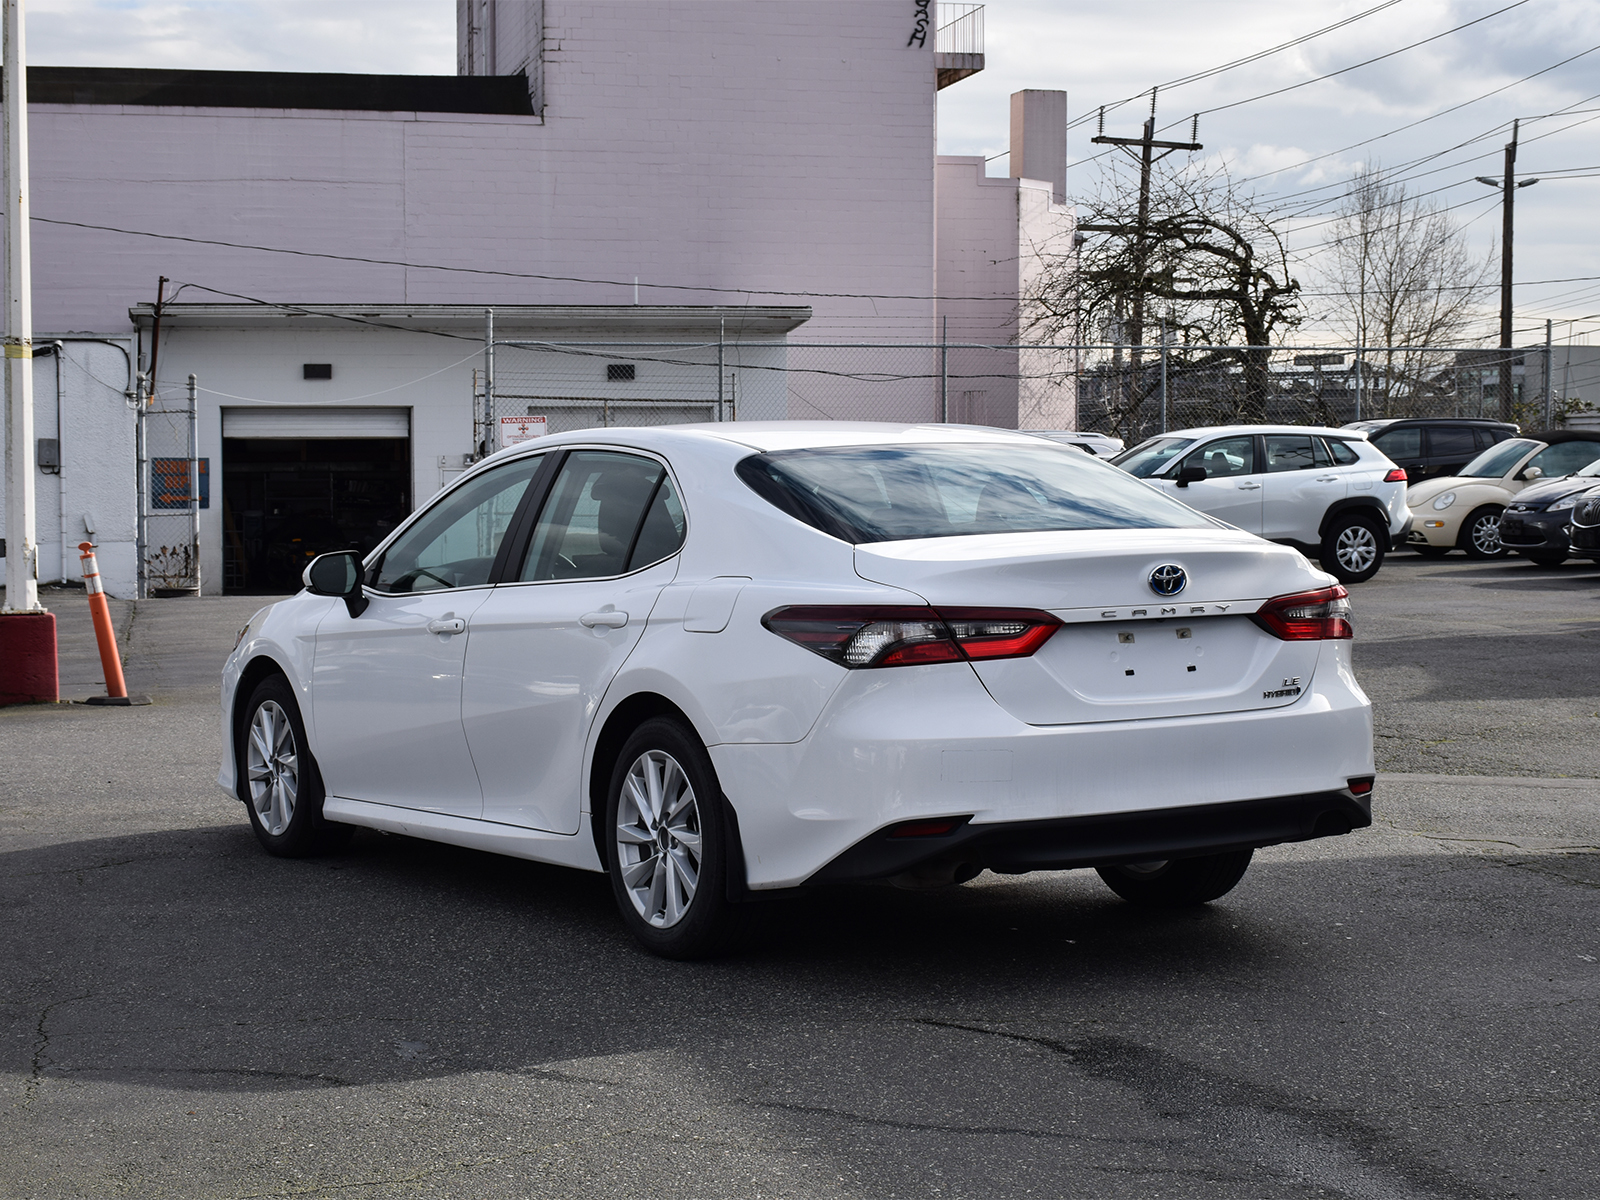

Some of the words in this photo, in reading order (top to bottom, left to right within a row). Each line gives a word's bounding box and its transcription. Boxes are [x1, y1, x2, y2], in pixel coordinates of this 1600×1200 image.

[155, 460, 206, 474] SERVIE
[1101, 604, 1232, 618] CAMRY
[1282, 676, 1301, 687] LE
[1263, 688, 1297, 699] HYBRID
